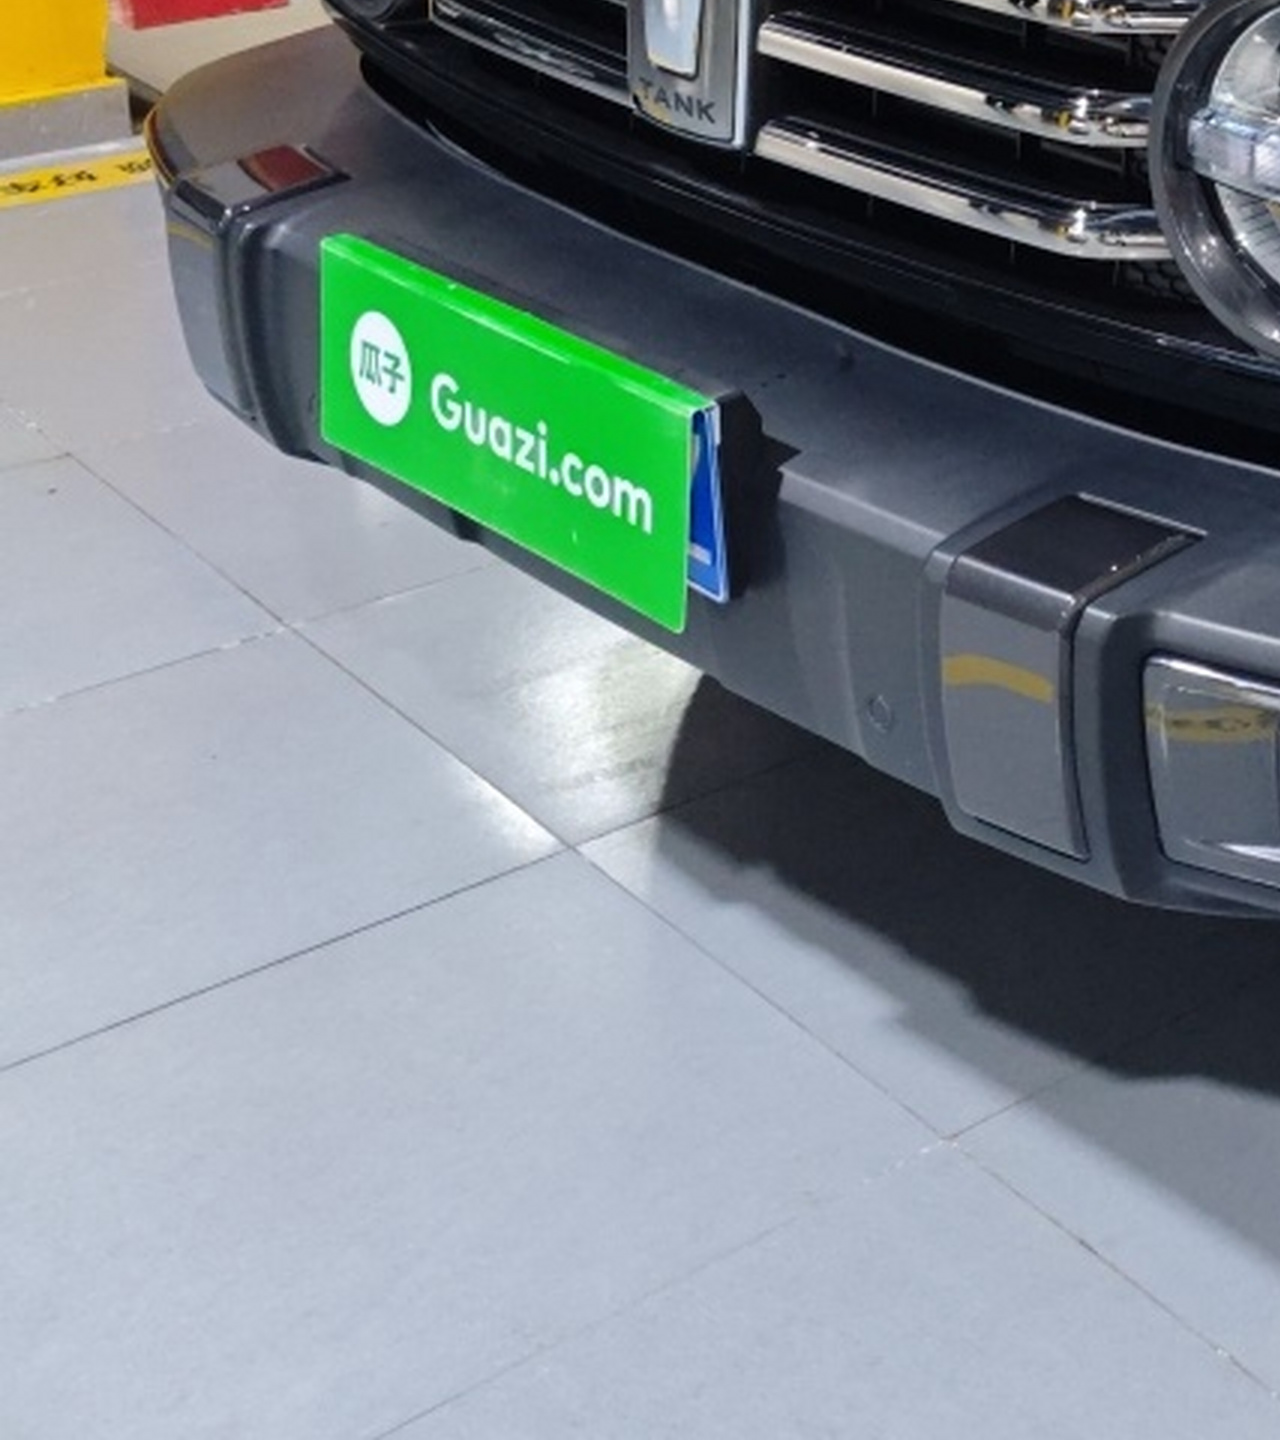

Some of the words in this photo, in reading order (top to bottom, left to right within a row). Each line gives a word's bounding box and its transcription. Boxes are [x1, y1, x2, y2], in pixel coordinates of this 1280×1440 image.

[639, 76, 717, 124] TANK
[358, 339, 406, 395] 瓜子
[430, 372, 653, 536] Guazi.com
